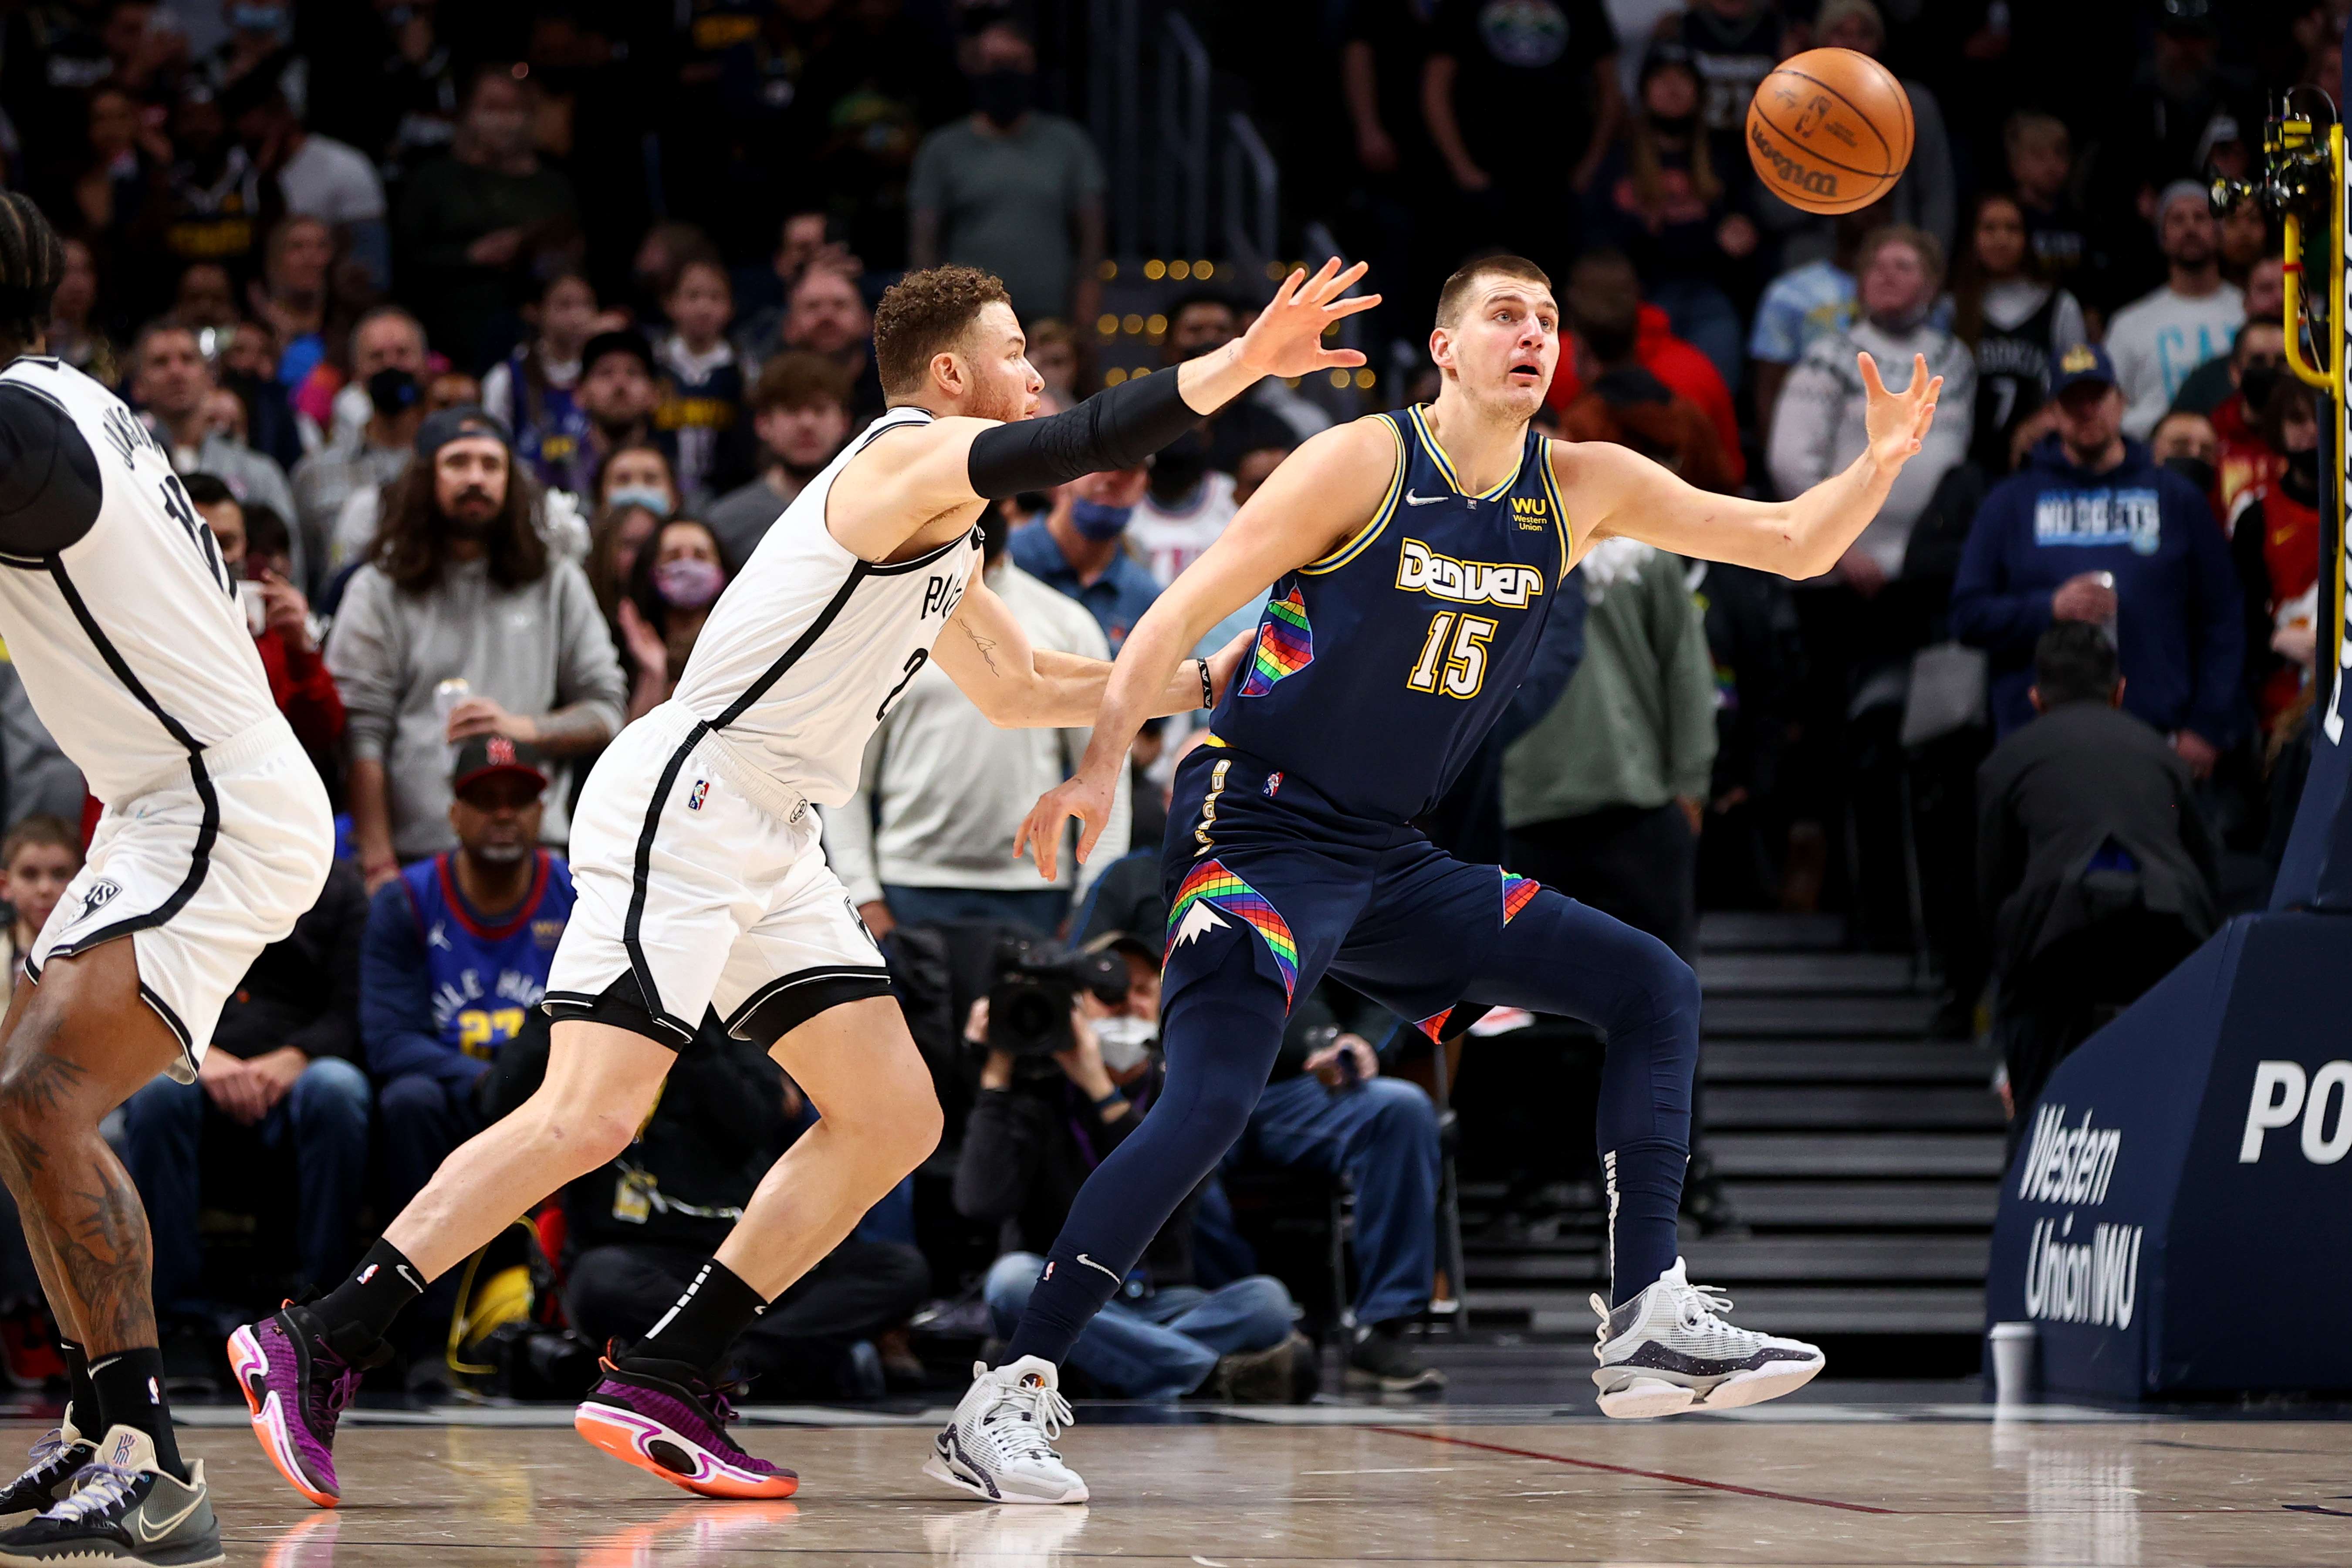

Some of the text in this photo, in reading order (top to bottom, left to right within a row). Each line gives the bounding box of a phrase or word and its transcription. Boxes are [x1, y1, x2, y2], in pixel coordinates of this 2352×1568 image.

[1511, 497, 1546, 515] WU
[1513, 514, 1548, 524] Western
[1519, 523, 1542, 531] Union
[1406, 610, 1499, 700] 15
[459, 1008, 526, 1060] 27
[2017, 1102, 2121, 1206] Western
